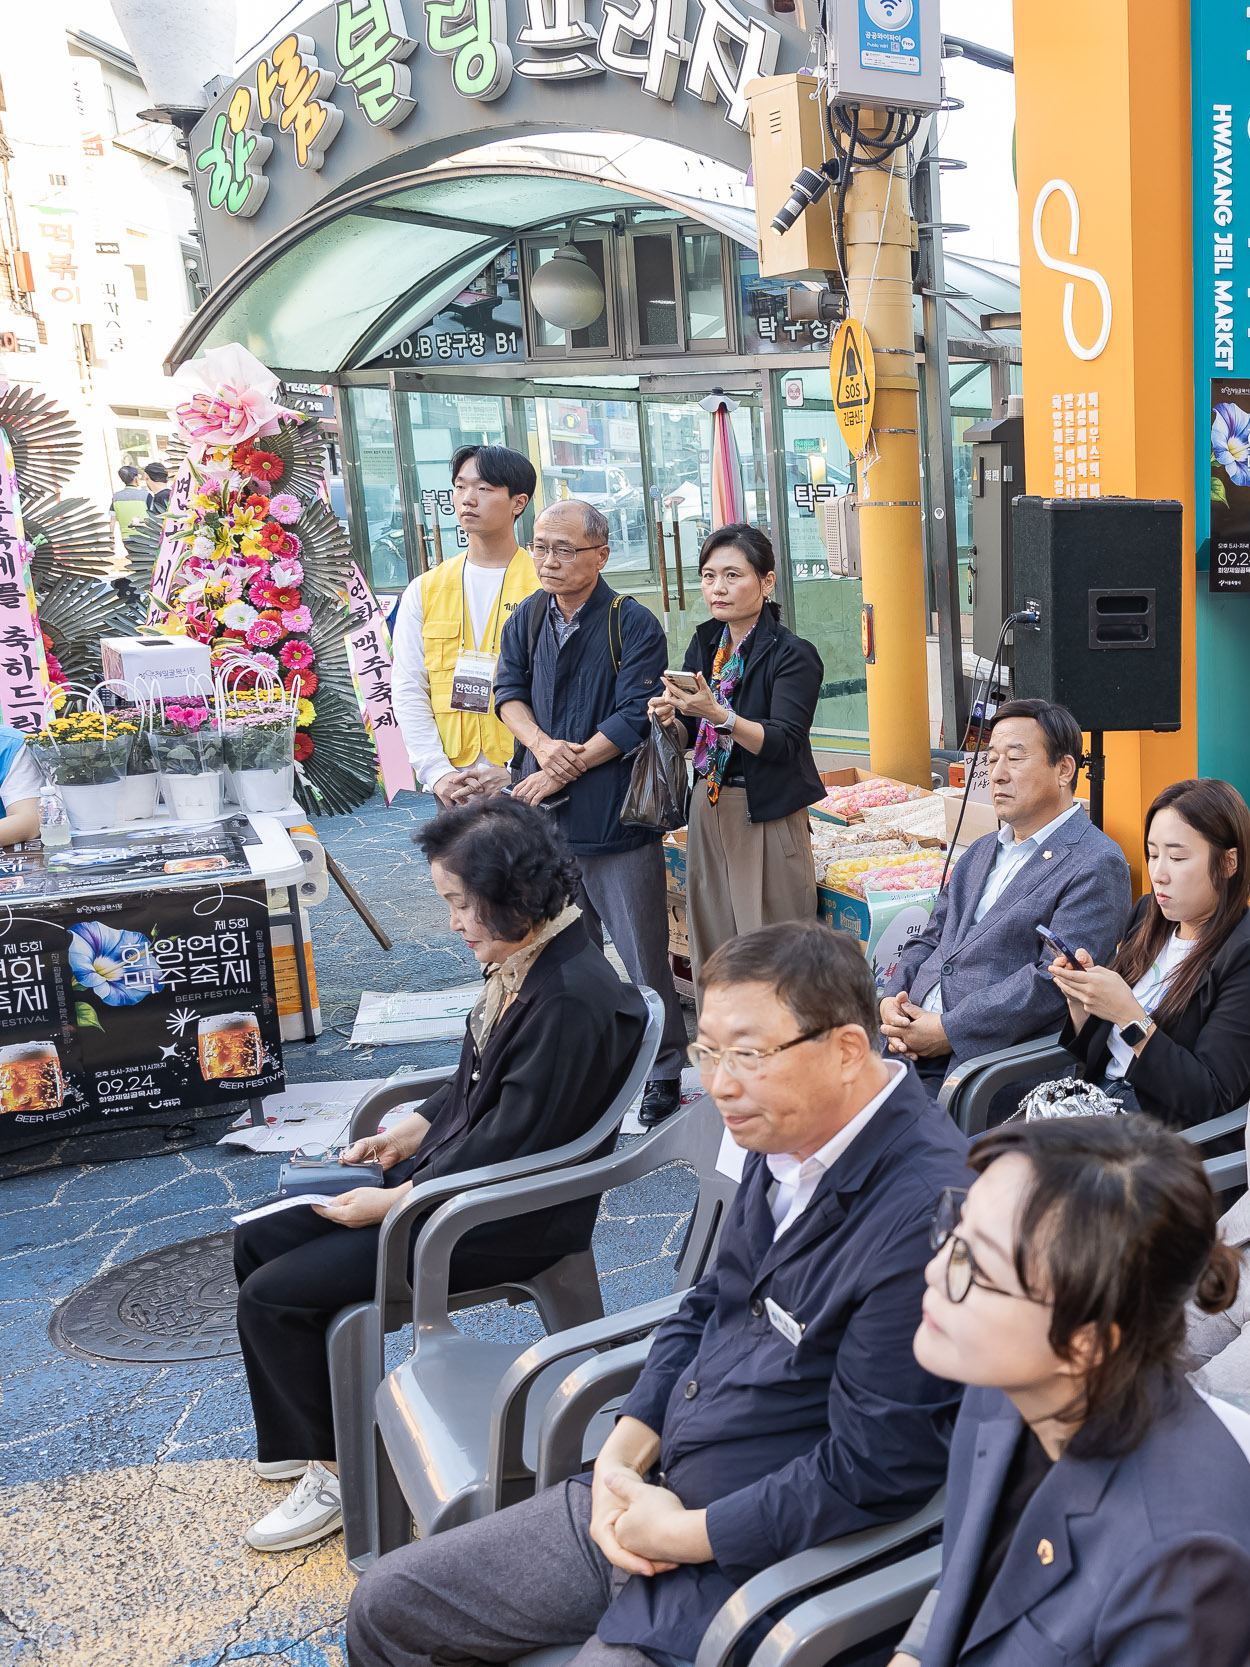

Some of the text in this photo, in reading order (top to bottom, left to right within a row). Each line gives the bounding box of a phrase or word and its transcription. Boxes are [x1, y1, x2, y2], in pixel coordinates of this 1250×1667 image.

[196, 32, 340, 216] 한아름
[1212, 104, 1234, 371] HWAYANG JEIL MARKET
[436, 333, 485, 358] 당구장
[496, 331, 517, 353] B1
[845, 382, 860, 399] SOS
[844, 411, 865, 427] 긴급신고
[352, 630, 398, 730] 맥주축제
[455, 682, 489, 697] 안전요원
[215, 917, 249, 931] 제 5회
[3, 941, 43, 955] 제 5회
[119, 931, 251, 970] 화양연화
[123, 959, 251, 995] 맥주축제
[175, 987, 252, 1003] BEER FESTIVAL
[97, 1075, 155, 1095] 09.24
[219, 1080, 244, 1090] BEER
[98, 1088, 161, 1103] 화양제일골목시장
[15, 1114, 44, 1124] BEER
